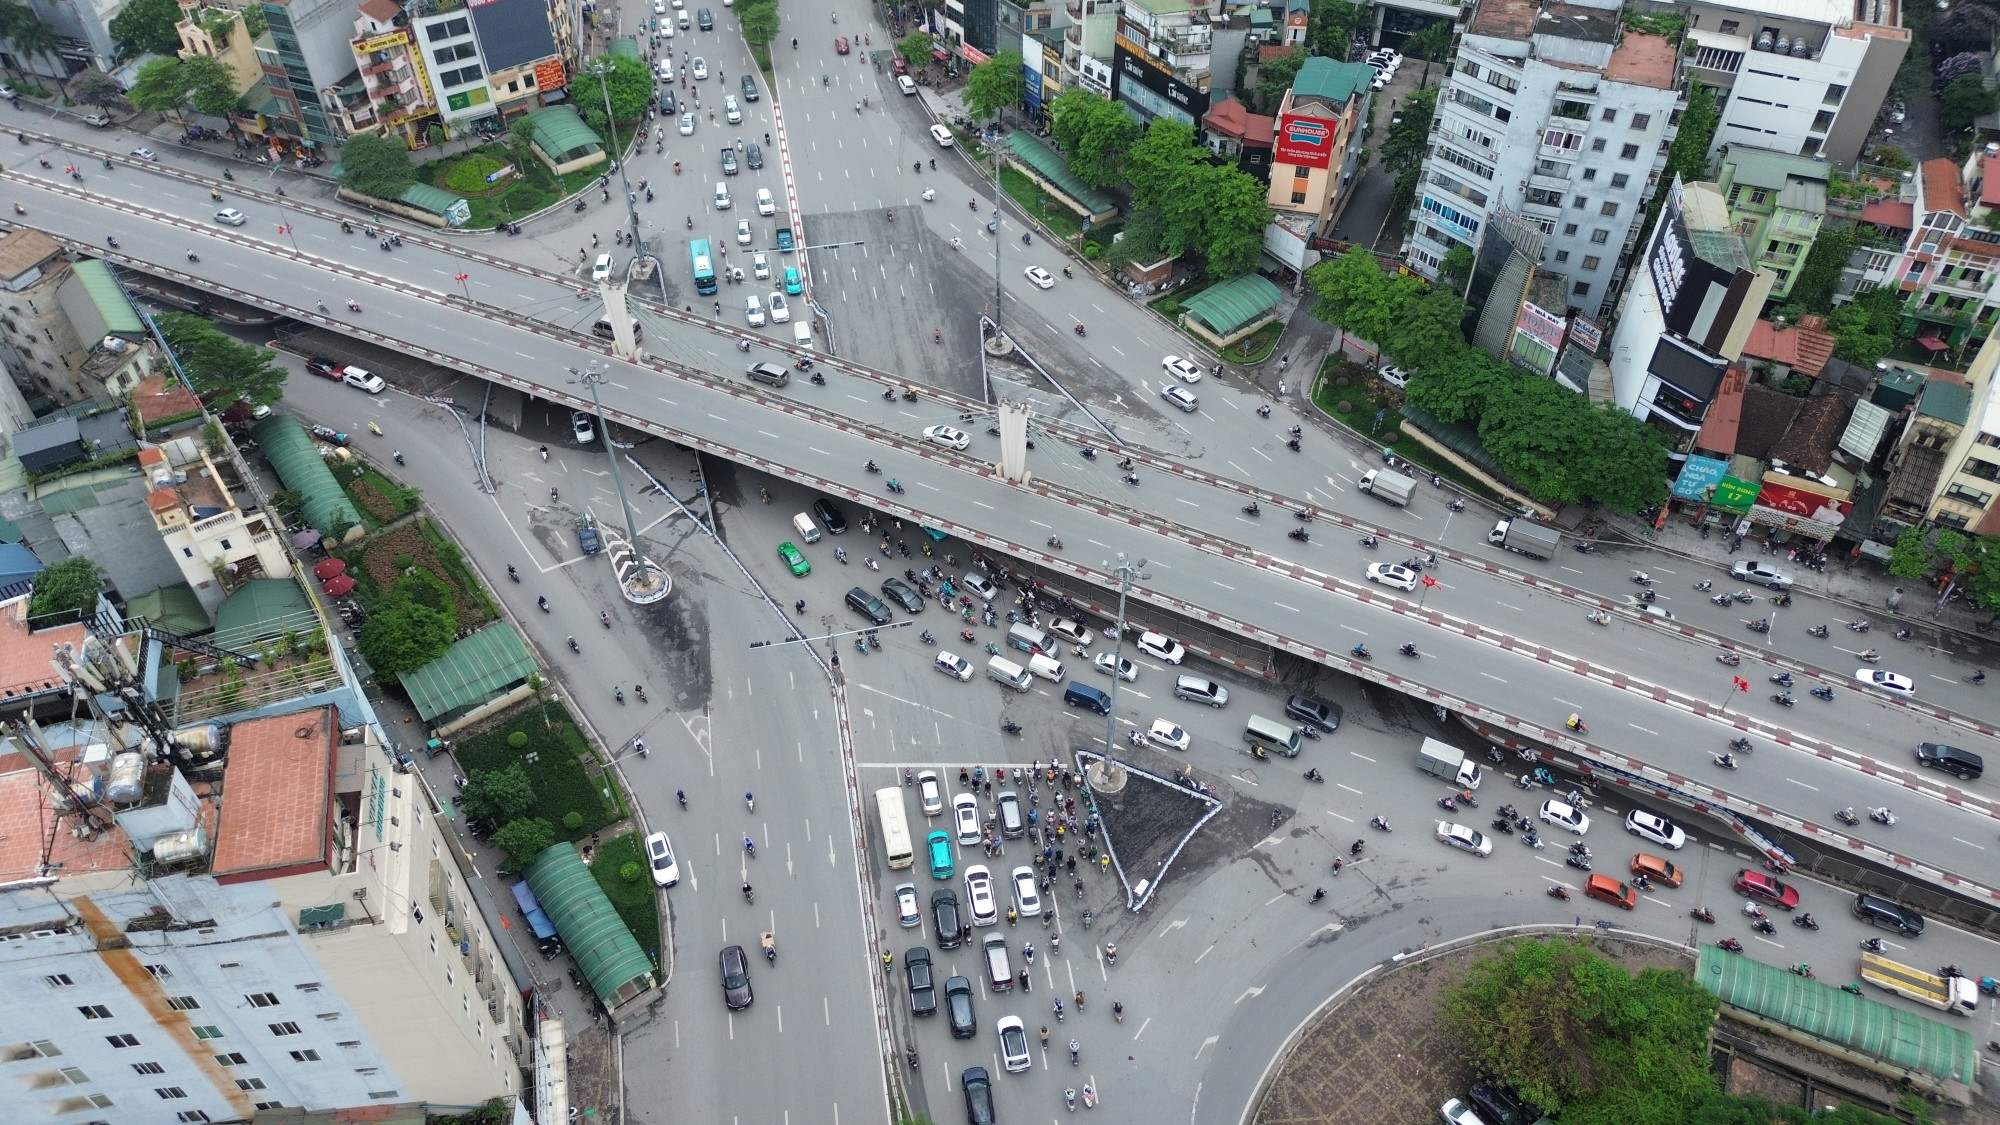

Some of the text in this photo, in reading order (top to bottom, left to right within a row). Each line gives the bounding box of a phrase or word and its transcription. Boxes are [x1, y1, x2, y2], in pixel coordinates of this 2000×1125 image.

[1289, 126, 1326, 136] SUNHOUSE
[1547, 316, 1559, 325] MAY
[1728, 492, 1742, 501] 17
